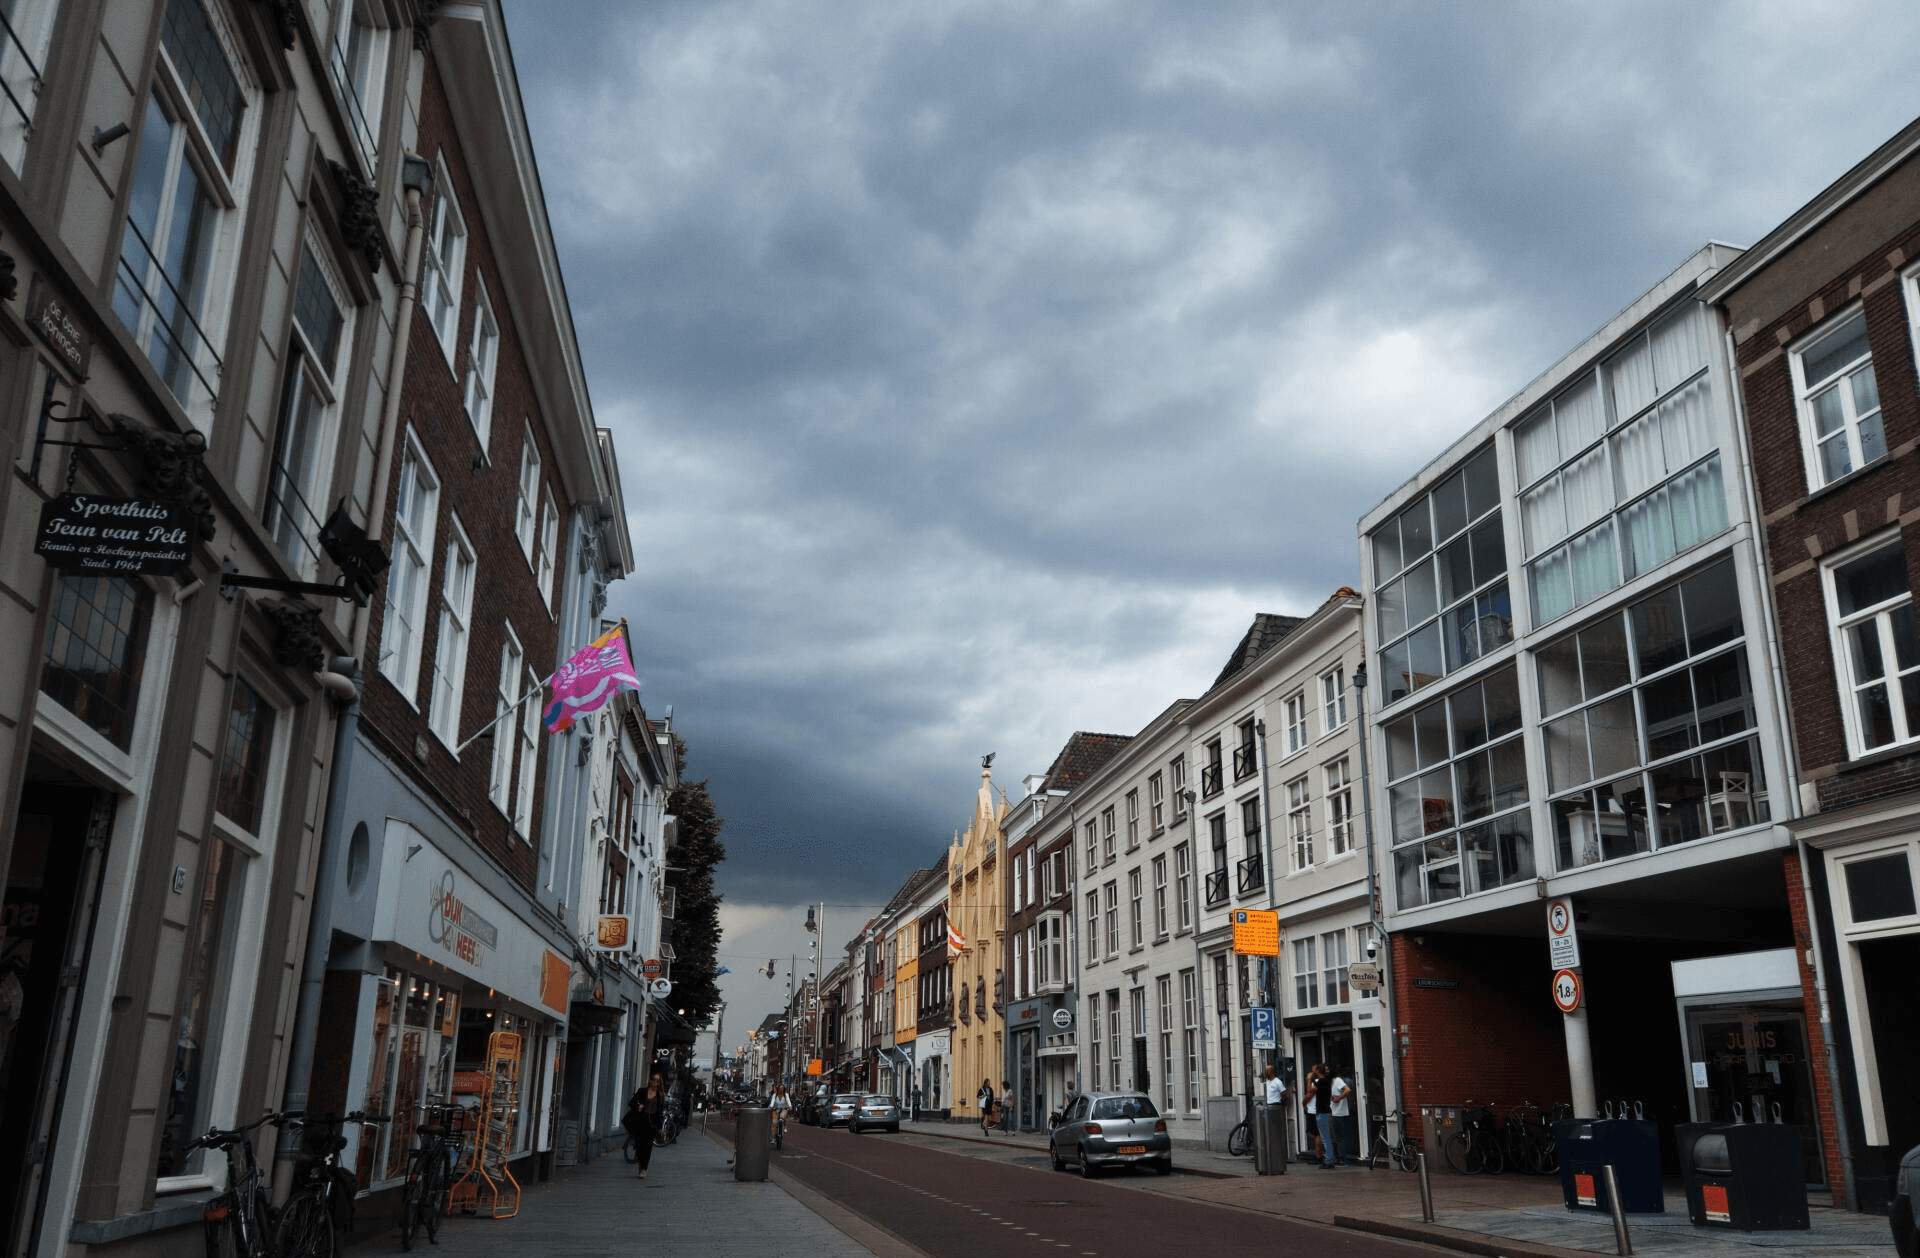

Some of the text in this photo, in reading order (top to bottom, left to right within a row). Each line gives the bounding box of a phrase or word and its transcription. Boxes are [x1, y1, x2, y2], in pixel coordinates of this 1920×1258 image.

[70, 496, 169, 520] Sporthuis
[46, 518, 188, 545] Teun van Pelt
[40, 541, 188, 561] Tennis en Hockeyspecialist
[81, 557, 144, 572] Sinds 1964
